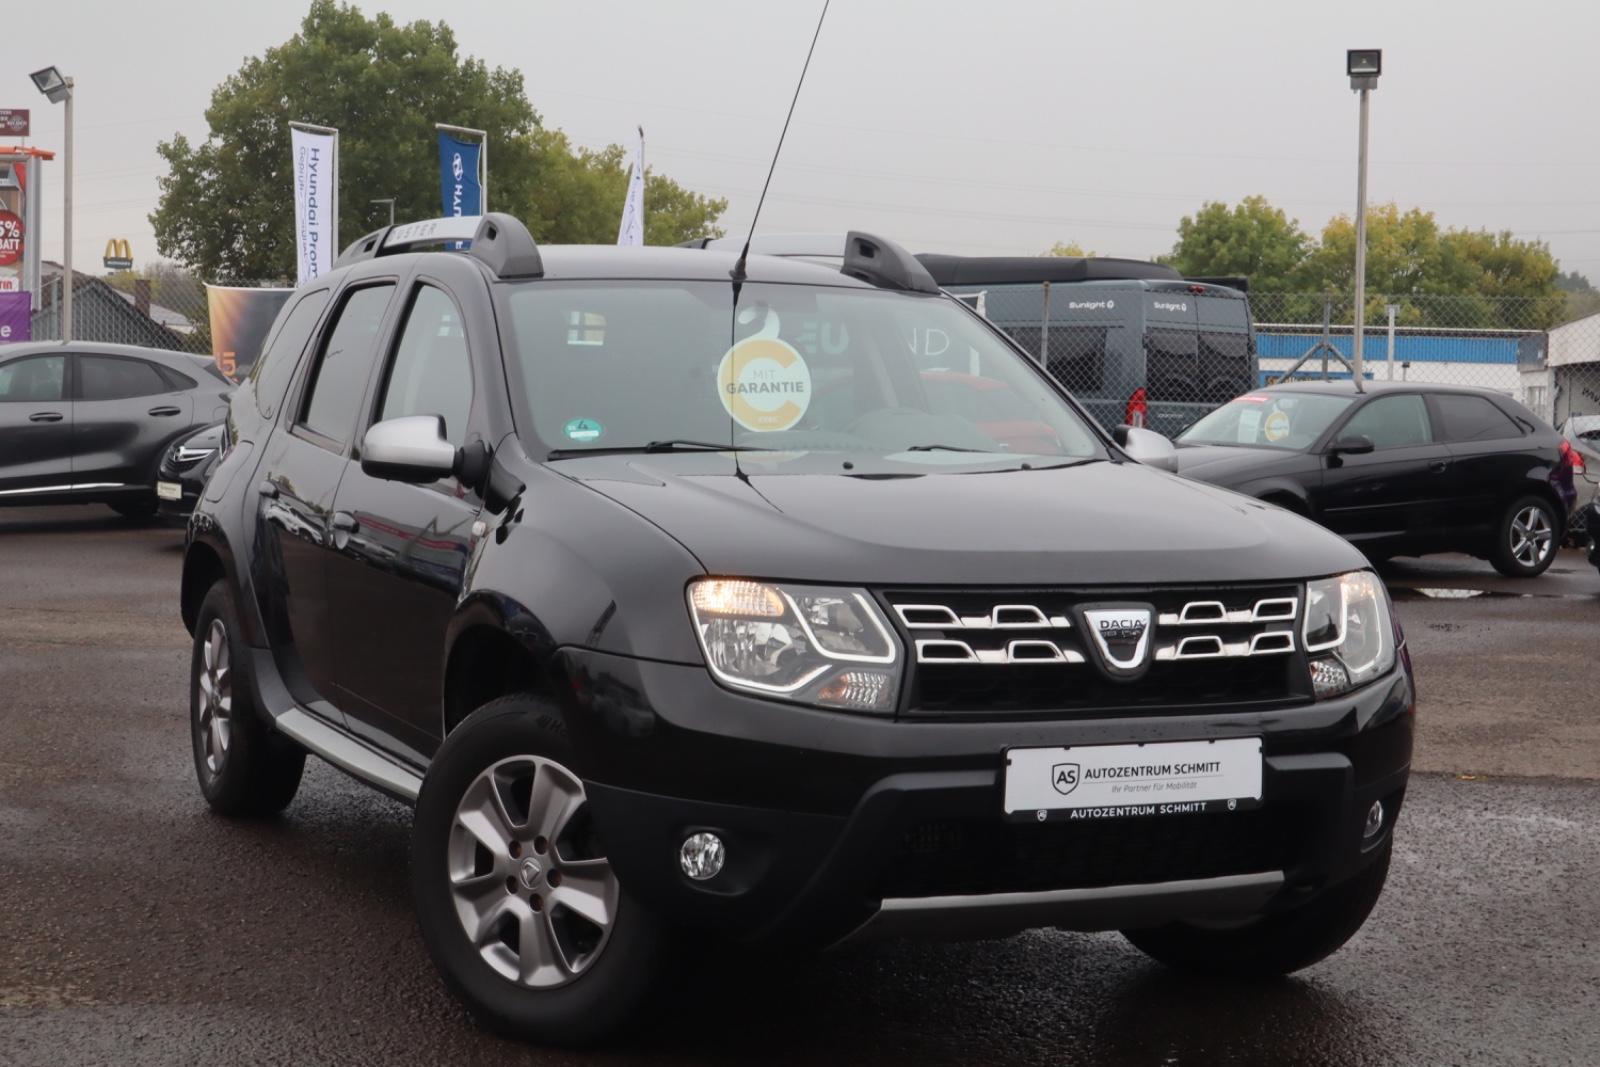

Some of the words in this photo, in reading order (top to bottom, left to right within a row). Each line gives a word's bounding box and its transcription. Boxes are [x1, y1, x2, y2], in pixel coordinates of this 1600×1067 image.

[308, 147, 320, 226] Hyundai
[1069, 301, 1105, 310] Sunlight
[752, 369, 776, 379] MIT
[726, 381, 804, 394] GARANTIE
[1099, 619, 1142, 629] DACIA
[1085, 764, 1171, 779] AUTOZENTRUM
[1174, 761, 1221, 775] SCHMITT
[1056, 769, 1076, 785] AS
[1112, 785, 1122, 793] Ihr
[1124, 783, 1151, 793] Partner
[1153, 782, 1165, 792] für
[1166, 781, 1198, 791] Mobilität
[1071, 805, 1155, 819] AUTOZENTRUM
[1160, 801, 1207, 814] SCHMITT
